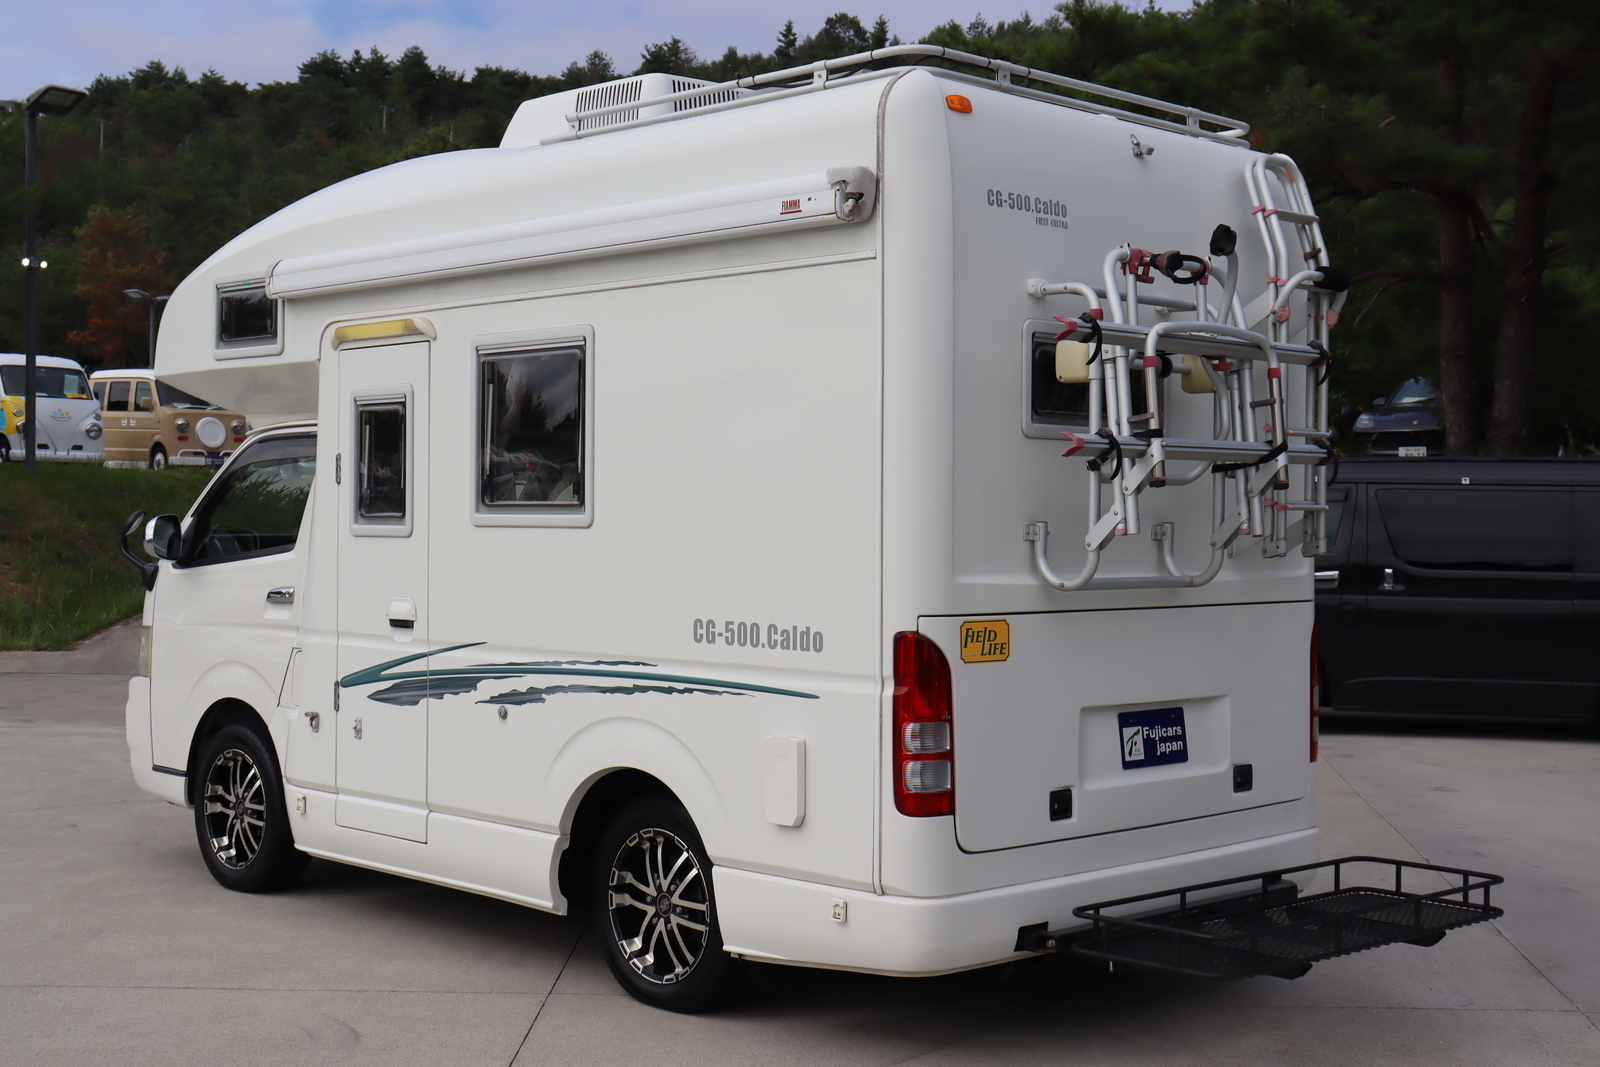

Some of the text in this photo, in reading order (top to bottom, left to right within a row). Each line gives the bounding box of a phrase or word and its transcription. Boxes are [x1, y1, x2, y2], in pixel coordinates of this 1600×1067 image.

[781, 198, 801, 212] FIAMMA
[986, 188, 1068, 218] CG-500.Caldo
[692, 617, 824, 653] CG-500.Caldo
[980, 641, 1008, 656] LIFE
[1142, 725, 1183, 741] Fujicars
[1156, 740, 1184, 756] japan
